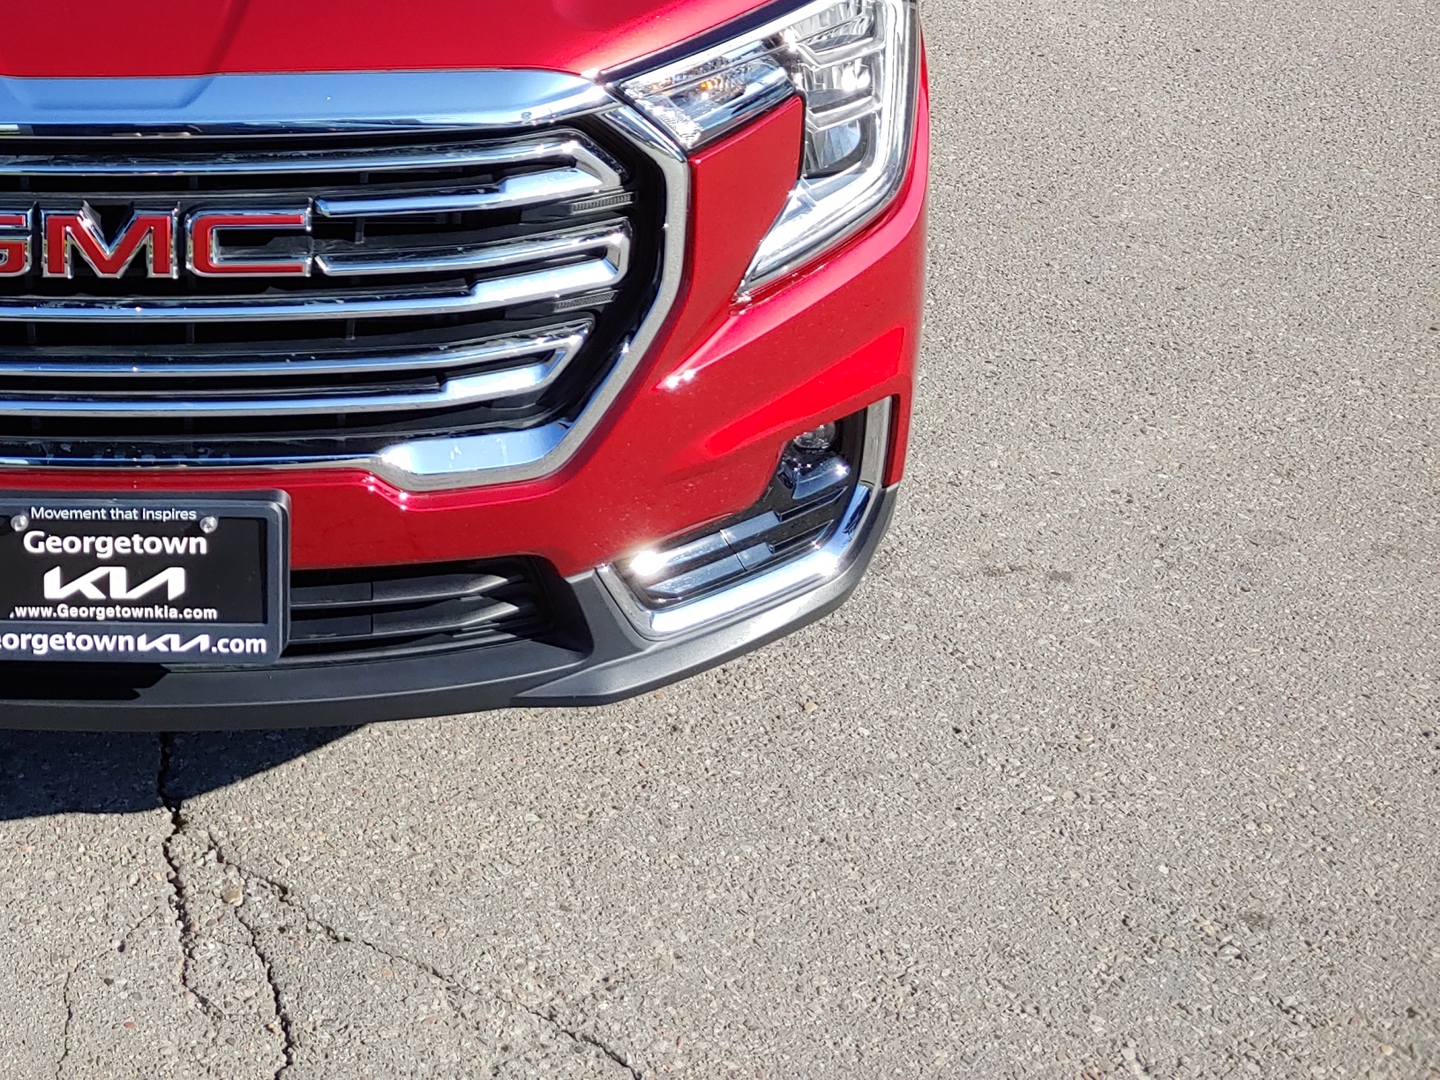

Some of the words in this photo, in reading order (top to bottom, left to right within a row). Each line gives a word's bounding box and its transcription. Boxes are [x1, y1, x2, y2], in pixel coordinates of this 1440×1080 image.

[31, 506, 107, 520] Movement
[109, 507, 139, 520] that
[142, 507, 197, 522] inspires
[23, 530, 208, 558] Georgetown
[44, 565, 186, 601] KIA
